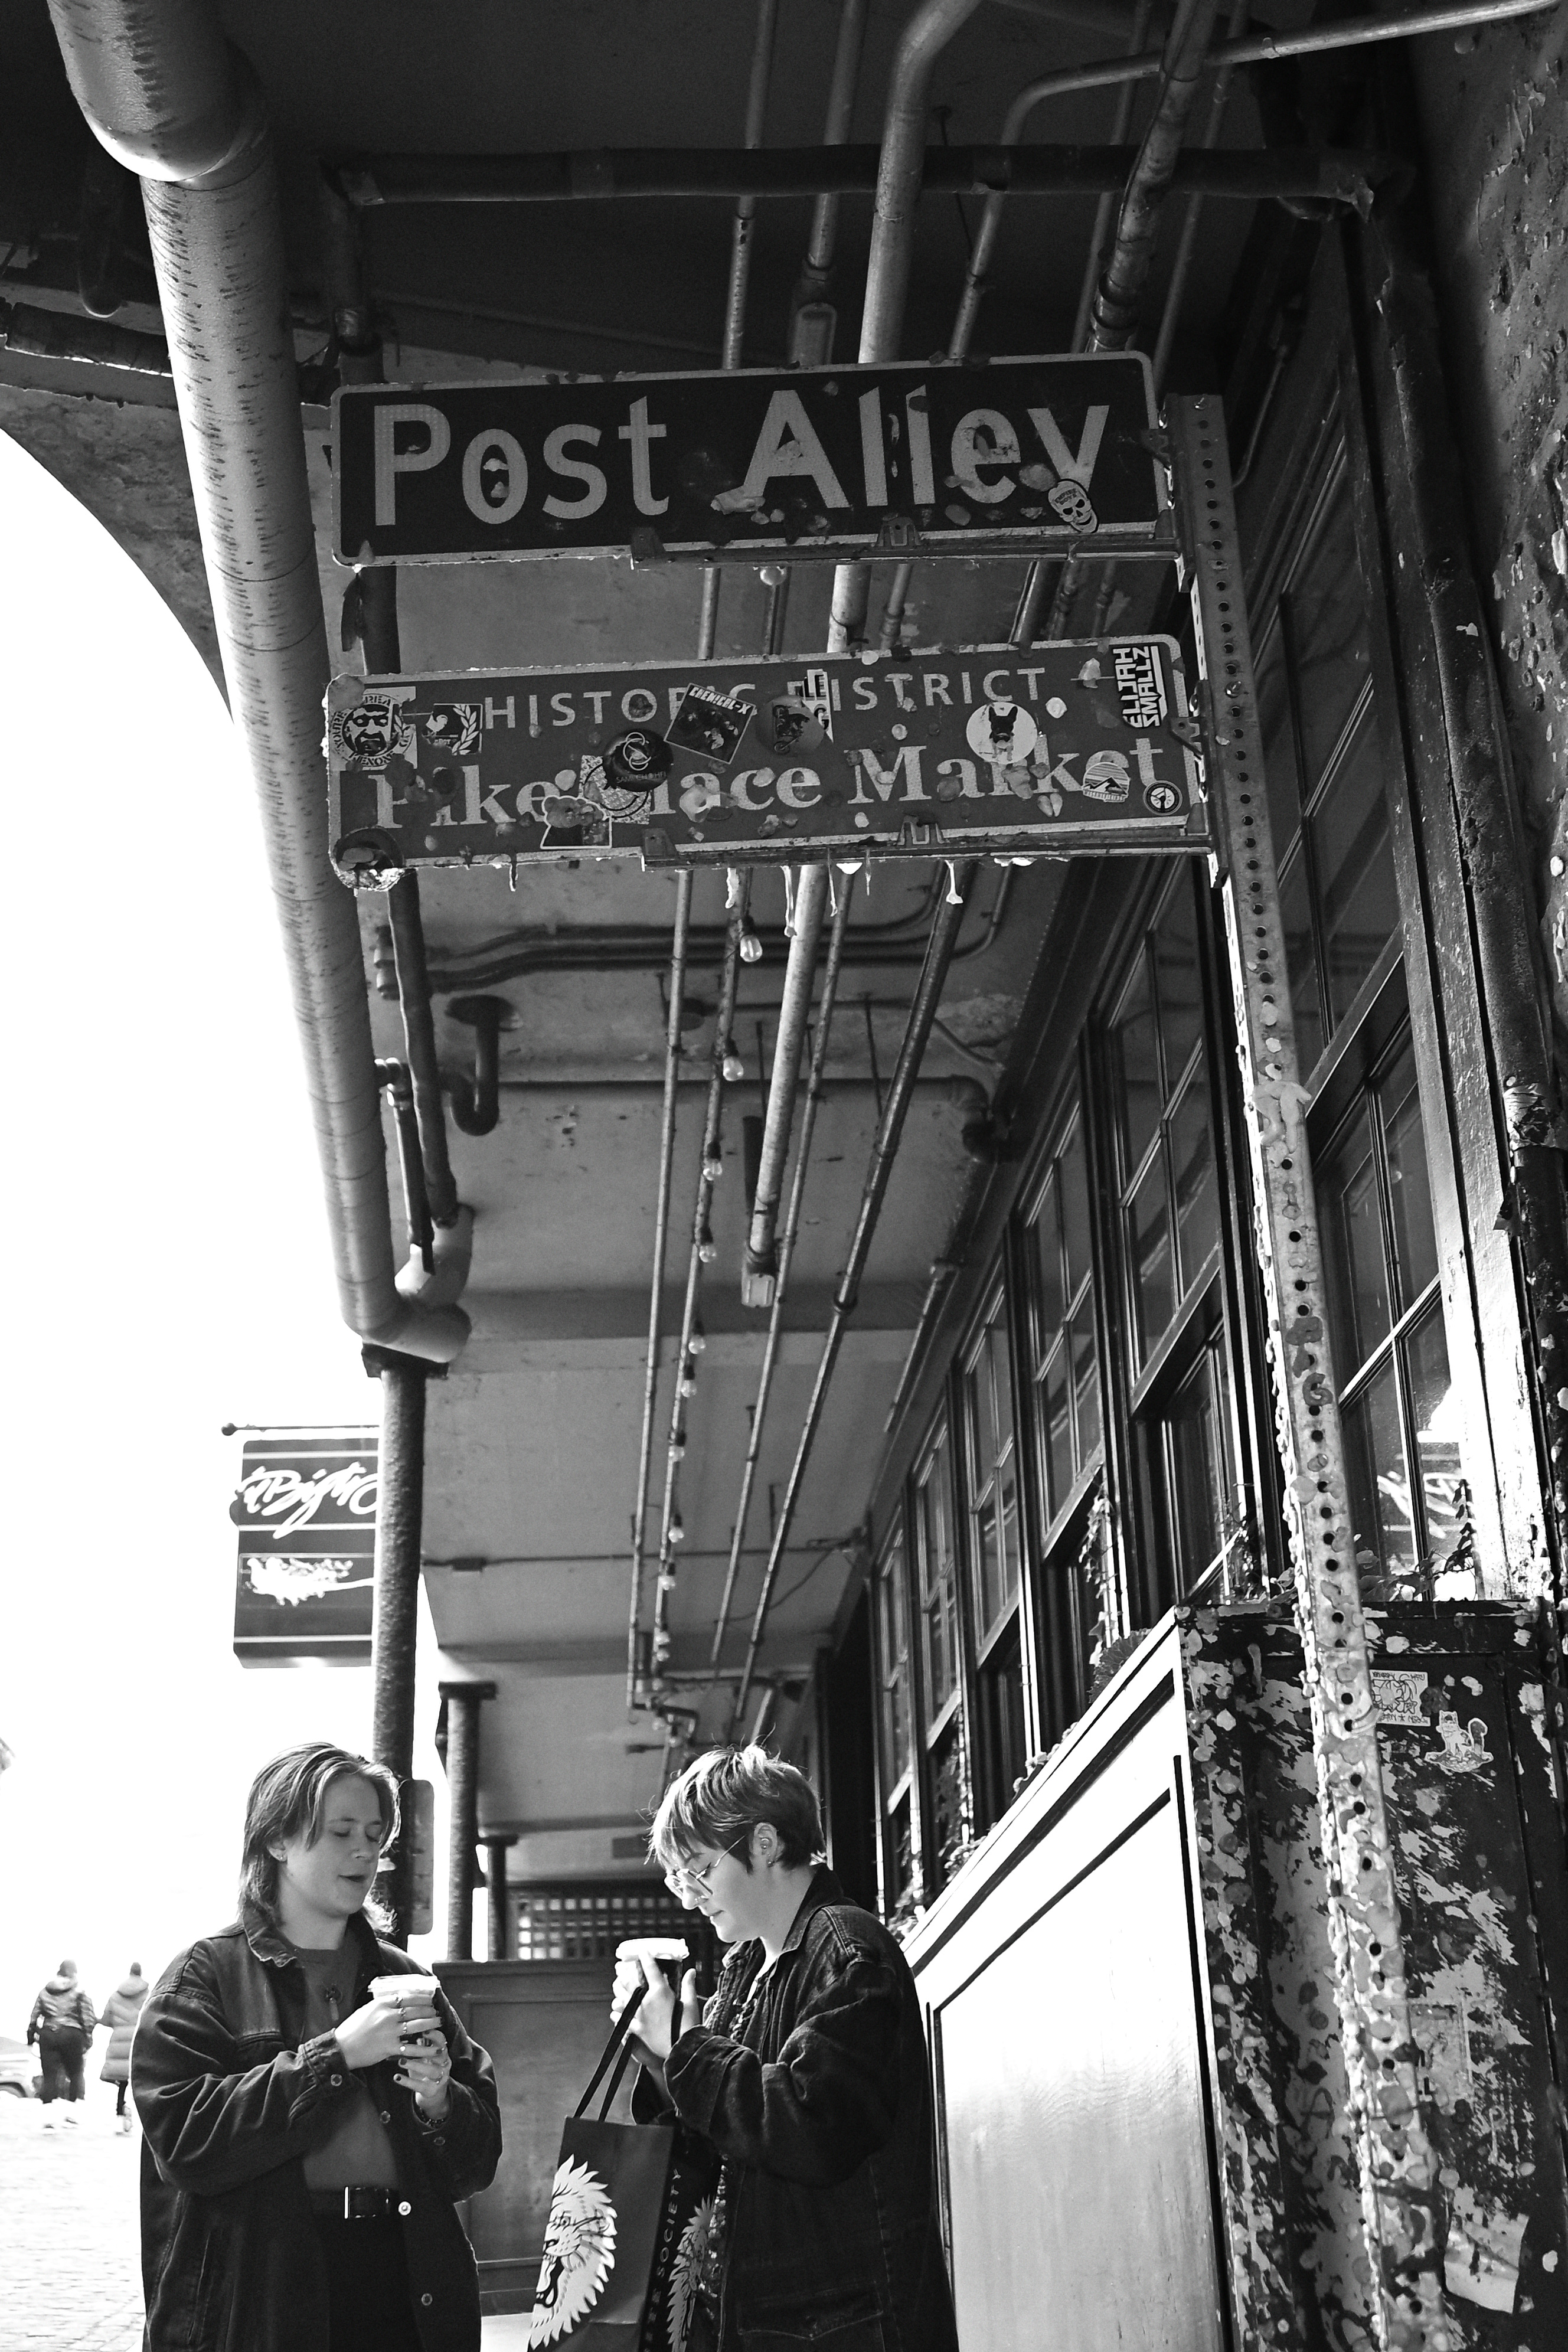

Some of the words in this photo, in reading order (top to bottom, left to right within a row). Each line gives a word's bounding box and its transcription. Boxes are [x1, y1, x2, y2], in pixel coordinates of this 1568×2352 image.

[374, 396, 669, 526] Post
[736, 384, 1110, 510] Alley
[485, 682, 757, 730] HISTORC
[787, 668, 1046, 712] ISTRICT
[1113, 648, 1143, 728] ELIJAH
[1132, 645, 1160, 727] SMALLZ
[656, 2168, 681, 2278] SOCIETY
